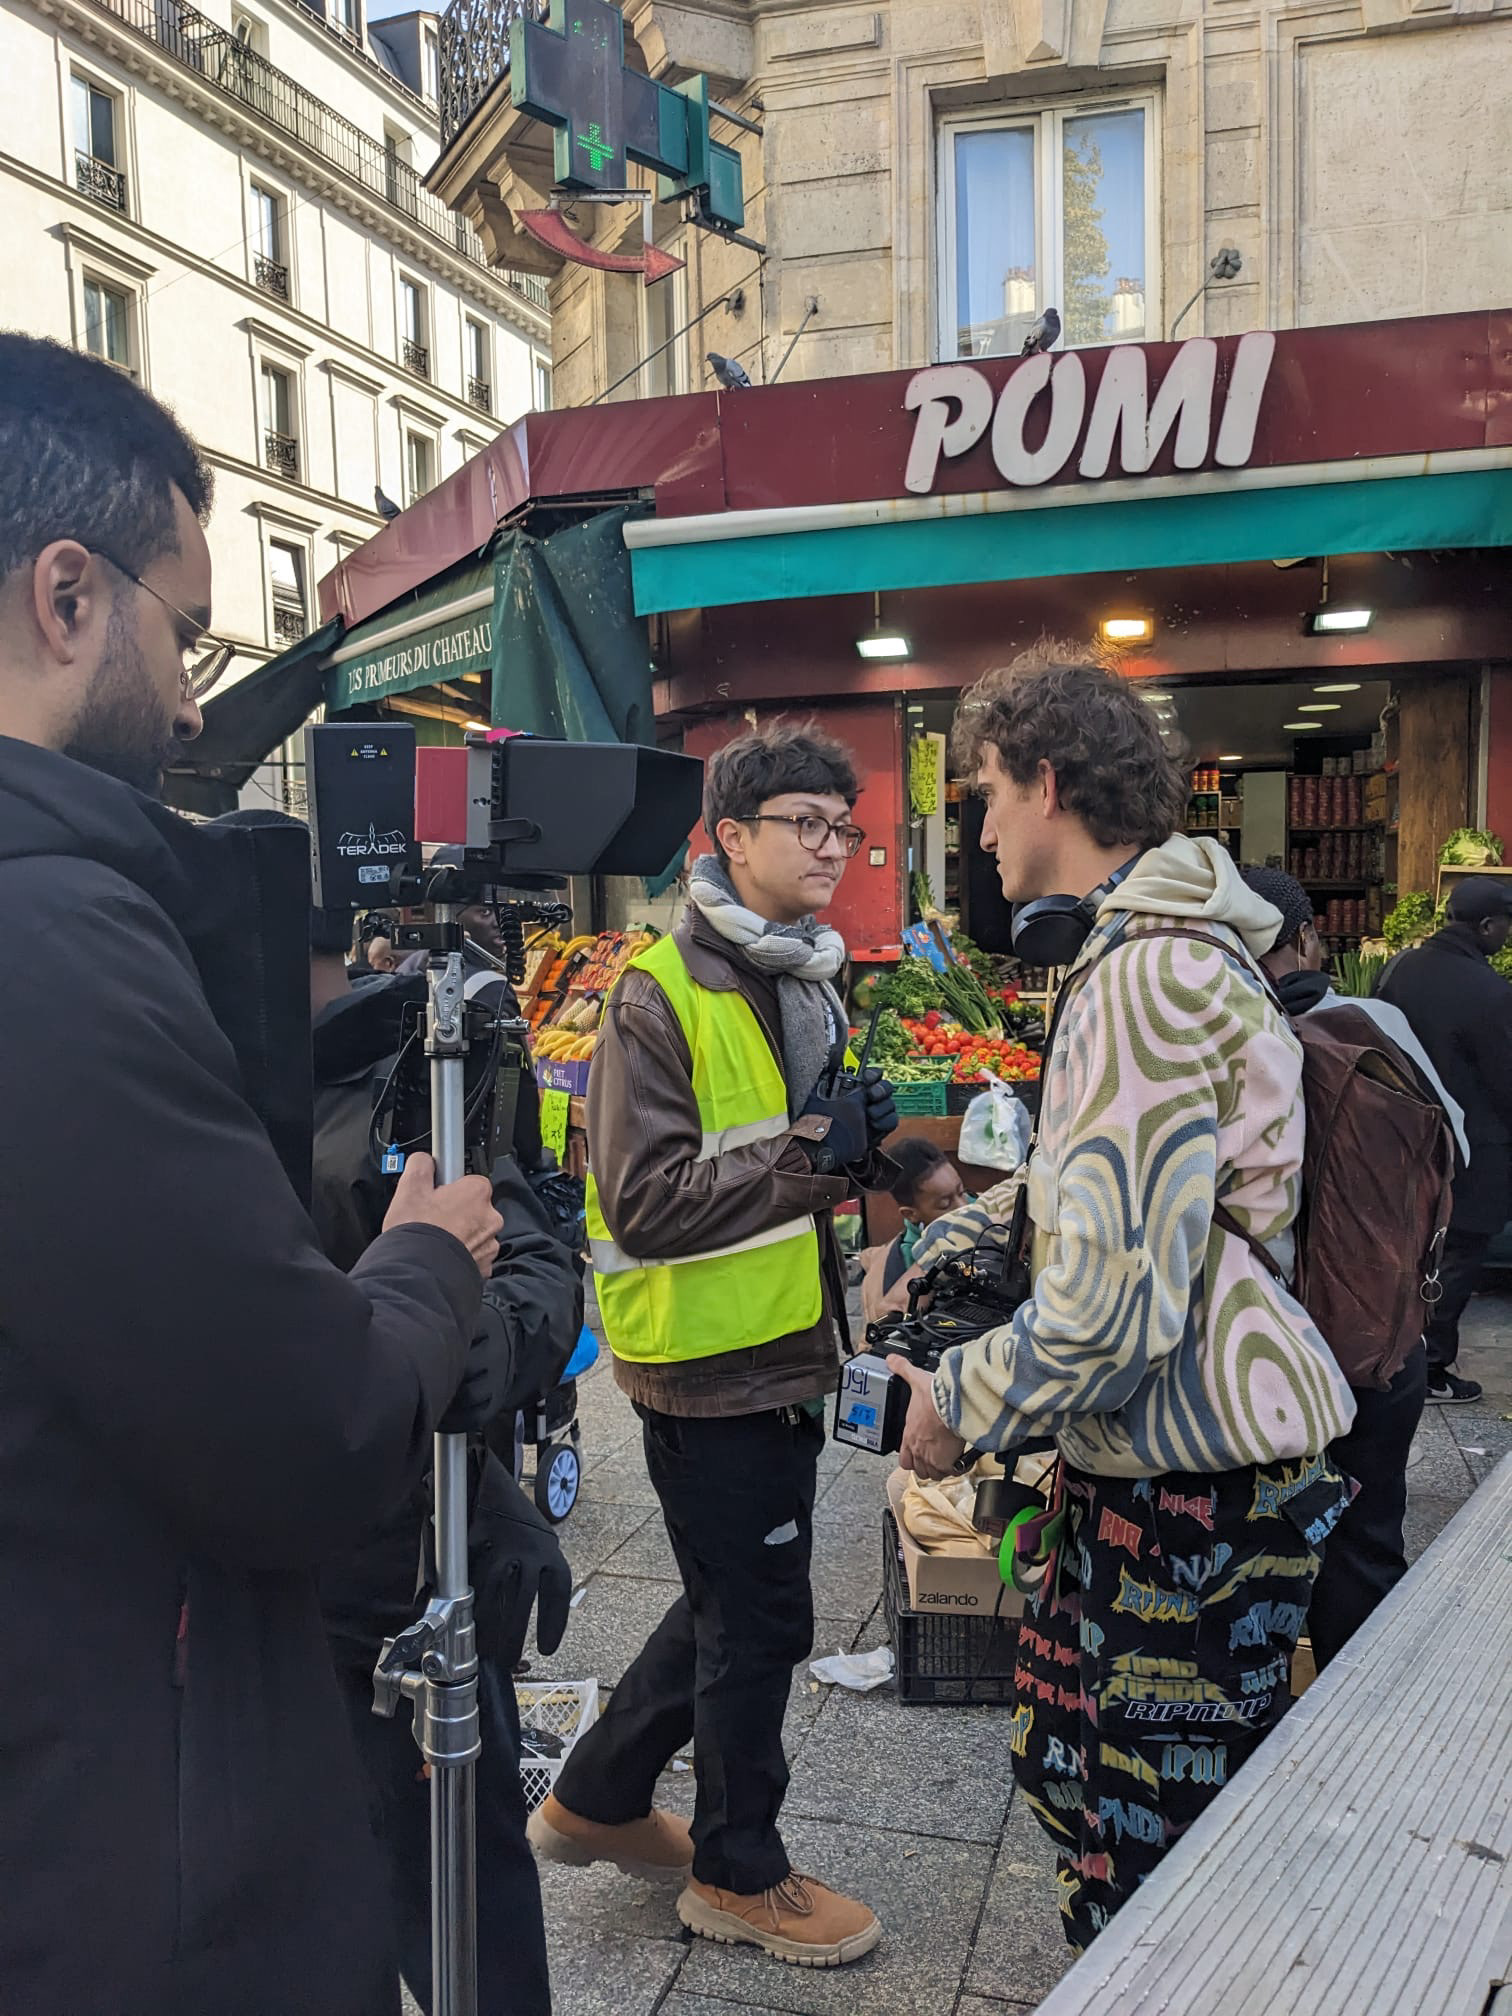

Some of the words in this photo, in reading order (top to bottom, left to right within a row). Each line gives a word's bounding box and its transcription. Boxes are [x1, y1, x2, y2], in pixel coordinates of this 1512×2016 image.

[904, 330, 1276, 494] POMI
[414, 643, 431, 672] DU
[432, 622, 493, 667] CHATEAU
[336, 843, 407, 856] TERADEK
[553, 1078, 573, 1089] CITRUS
[1158, 1485, 1215, 1531] NICE
[918, 1592, 979, 1606] zalando
[1125, 1692, 1272, 1722] RIPNDIP
